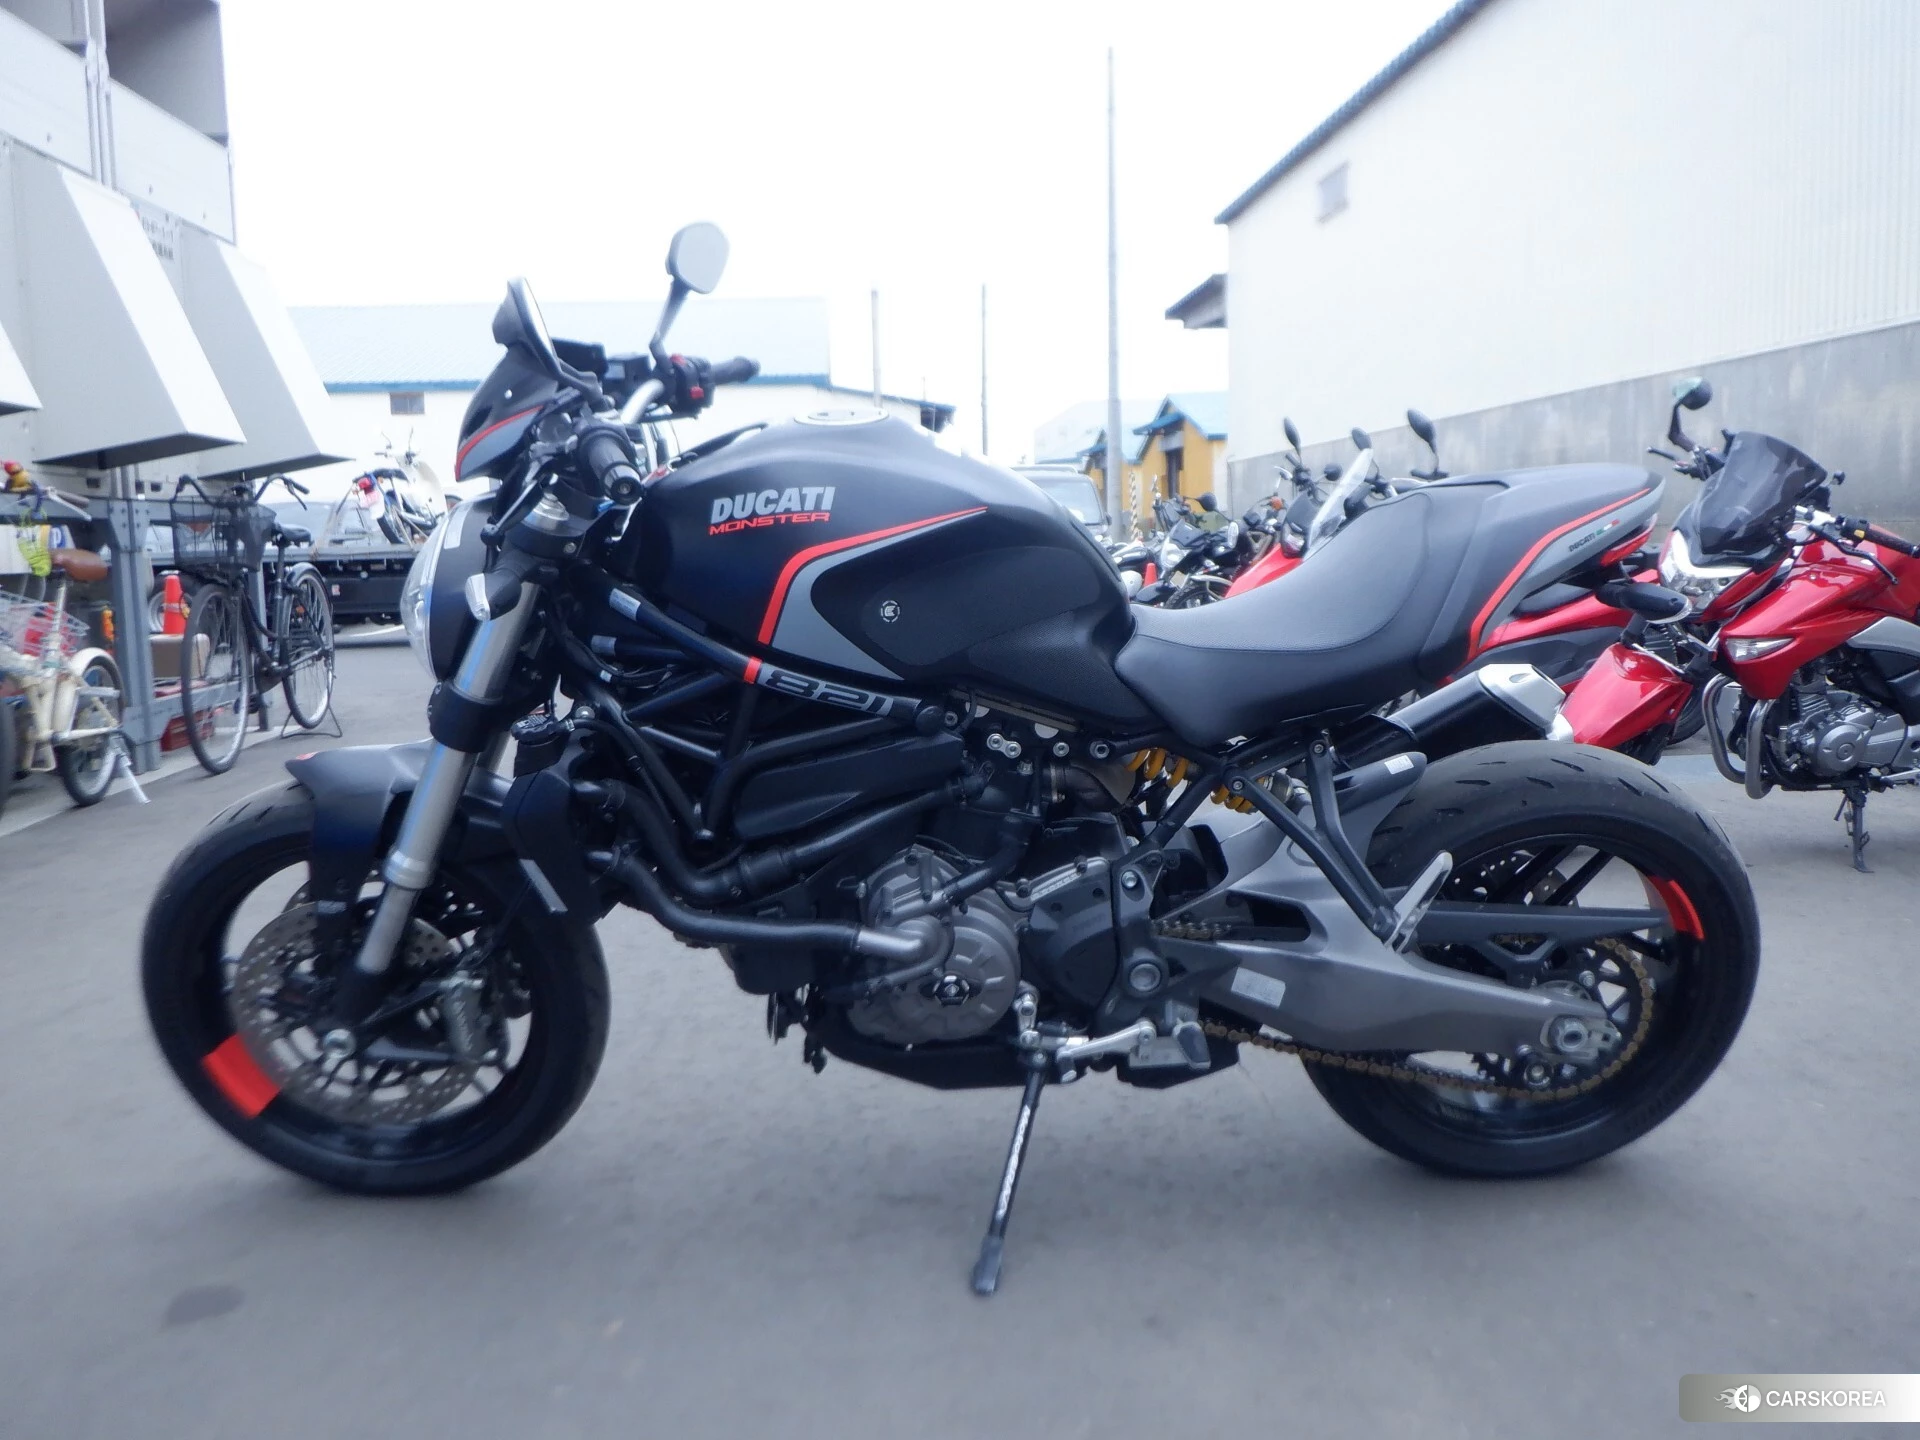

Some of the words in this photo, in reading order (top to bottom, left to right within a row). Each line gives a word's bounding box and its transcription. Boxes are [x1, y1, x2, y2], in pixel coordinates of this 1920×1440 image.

[711, 486, 836, 525] DUCATI
[708, 511, 831, 536] MONSTER
[1568, 533, 1596, 552] DUCATI
[765, 670, 888, 716] 821
